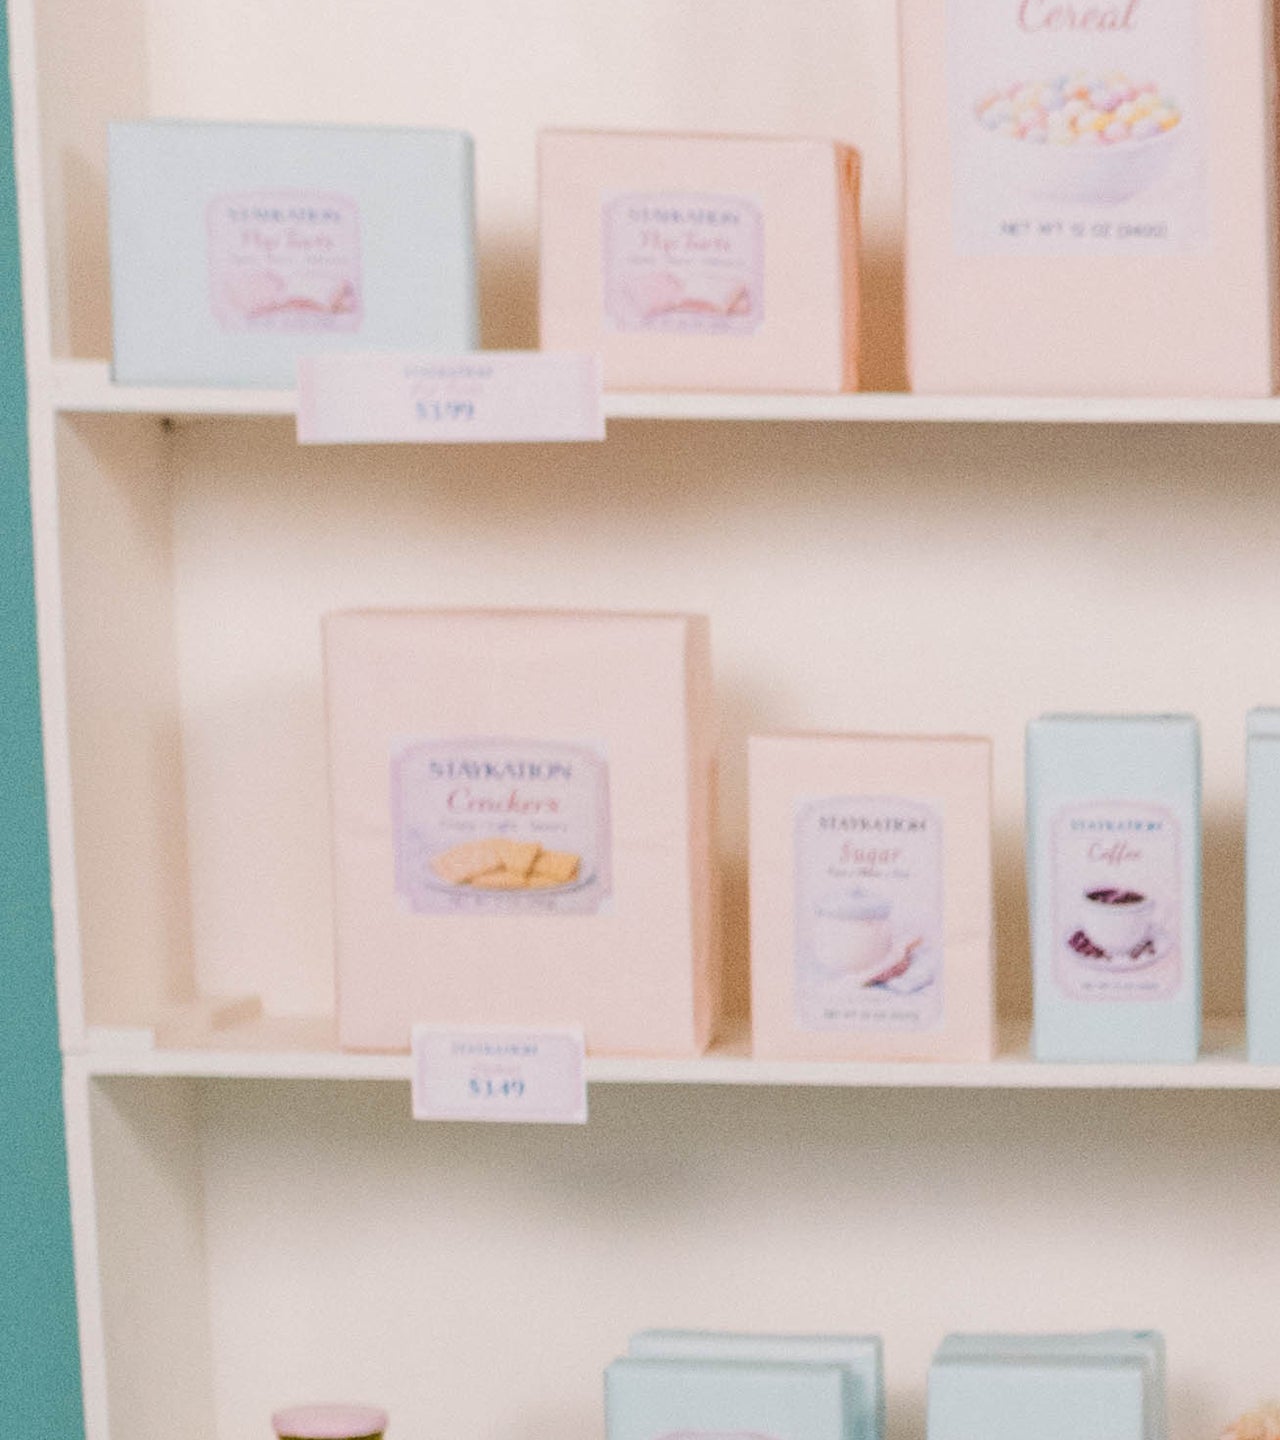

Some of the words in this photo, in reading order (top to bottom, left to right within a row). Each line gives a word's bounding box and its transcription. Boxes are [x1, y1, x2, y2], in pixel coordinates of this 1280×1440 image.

[428, 759, 573, 780] STAYKATION
[446, 786, 561, 814] Crackers
[819, 815, 927, 831] STAYKATION
[1071, 819, 1163, 831] STAYKATION
[839, 837, 904, 872] Sugar
[1087, 840, 1143, 866] Coffee
